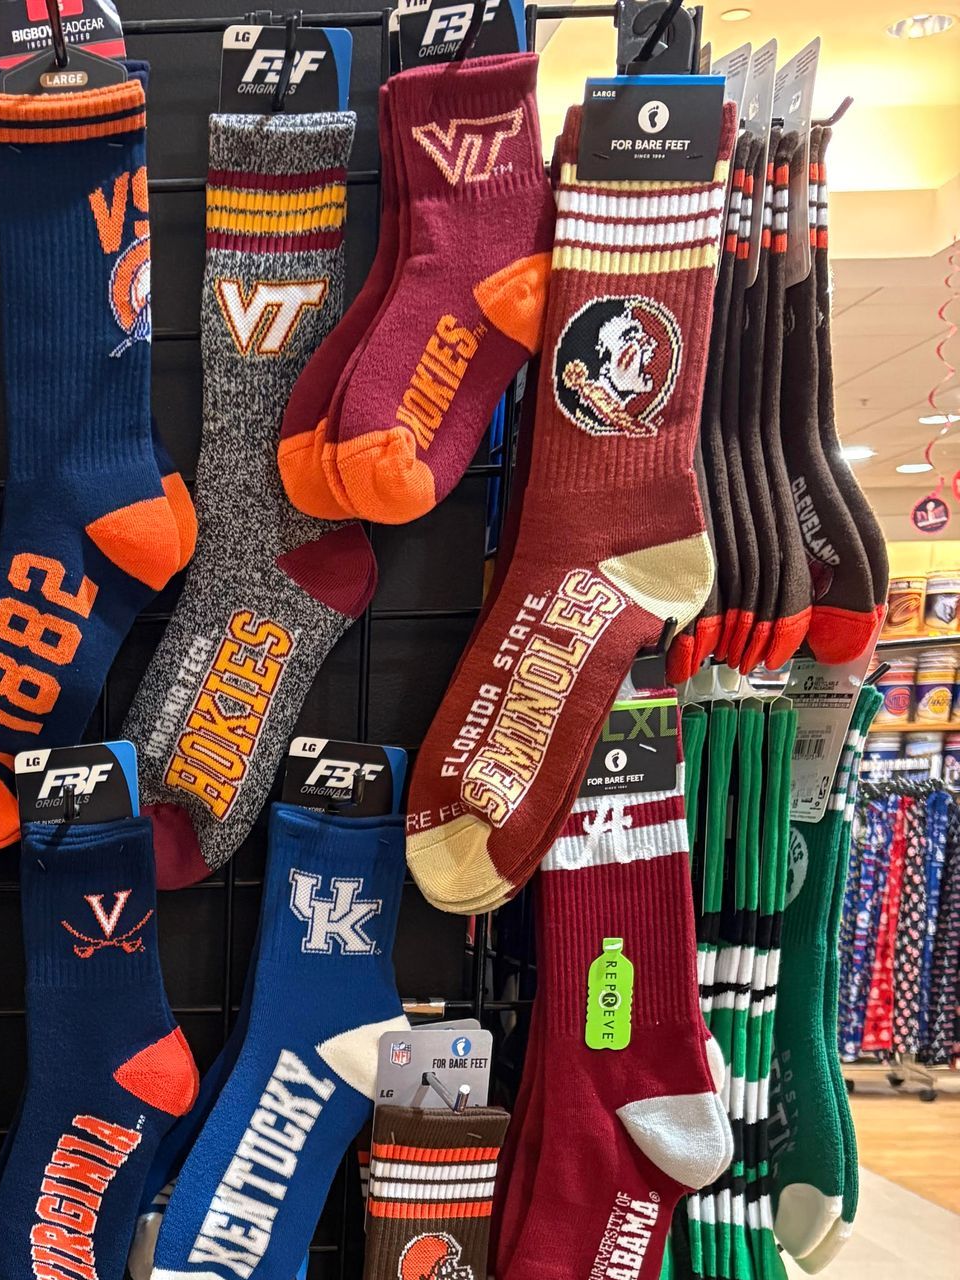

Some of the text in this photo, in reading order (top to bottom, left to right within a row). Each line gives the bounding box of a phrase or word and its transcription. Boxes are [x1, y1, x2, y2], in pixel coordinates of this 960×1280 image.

[234, 31, 251, 42] LG
[46, 73, 83, 86] LARGE
[237, 83, 298, 95] ORIGINS
[592, 90, 616, 98] LARGE
[411, 107, 524, 187] VT
[611, 139, 691, 151] FOR BARE FEET
[215, 276, 329, 357] VT
[791, 476, 840, 566] CLEVELAND
[441, 592, 546, 778] FLORIDA STATE
[460, 568, 628, 829] SEMINOLES
[162, 608, 294, 824] HOKIES
[301, 742, 317, 753] LG
[26, 757, 41, 767] LG
[587, 773, 645, 787] FOR BARE FEET
[35, 795, 91, 809] ORIGILS
[83, 889, 133, 940] V
[290, 868, 384, 956] UK
[600, 961, 619, 1041] REPREVE
[432, 1057, 488, 1070] FOR BARE FEET
[380, 1089, 394, 1098] LG
[187, 1049, 337, 1280] KENTUCKY
[615, 1191, 632, 1207] OF
